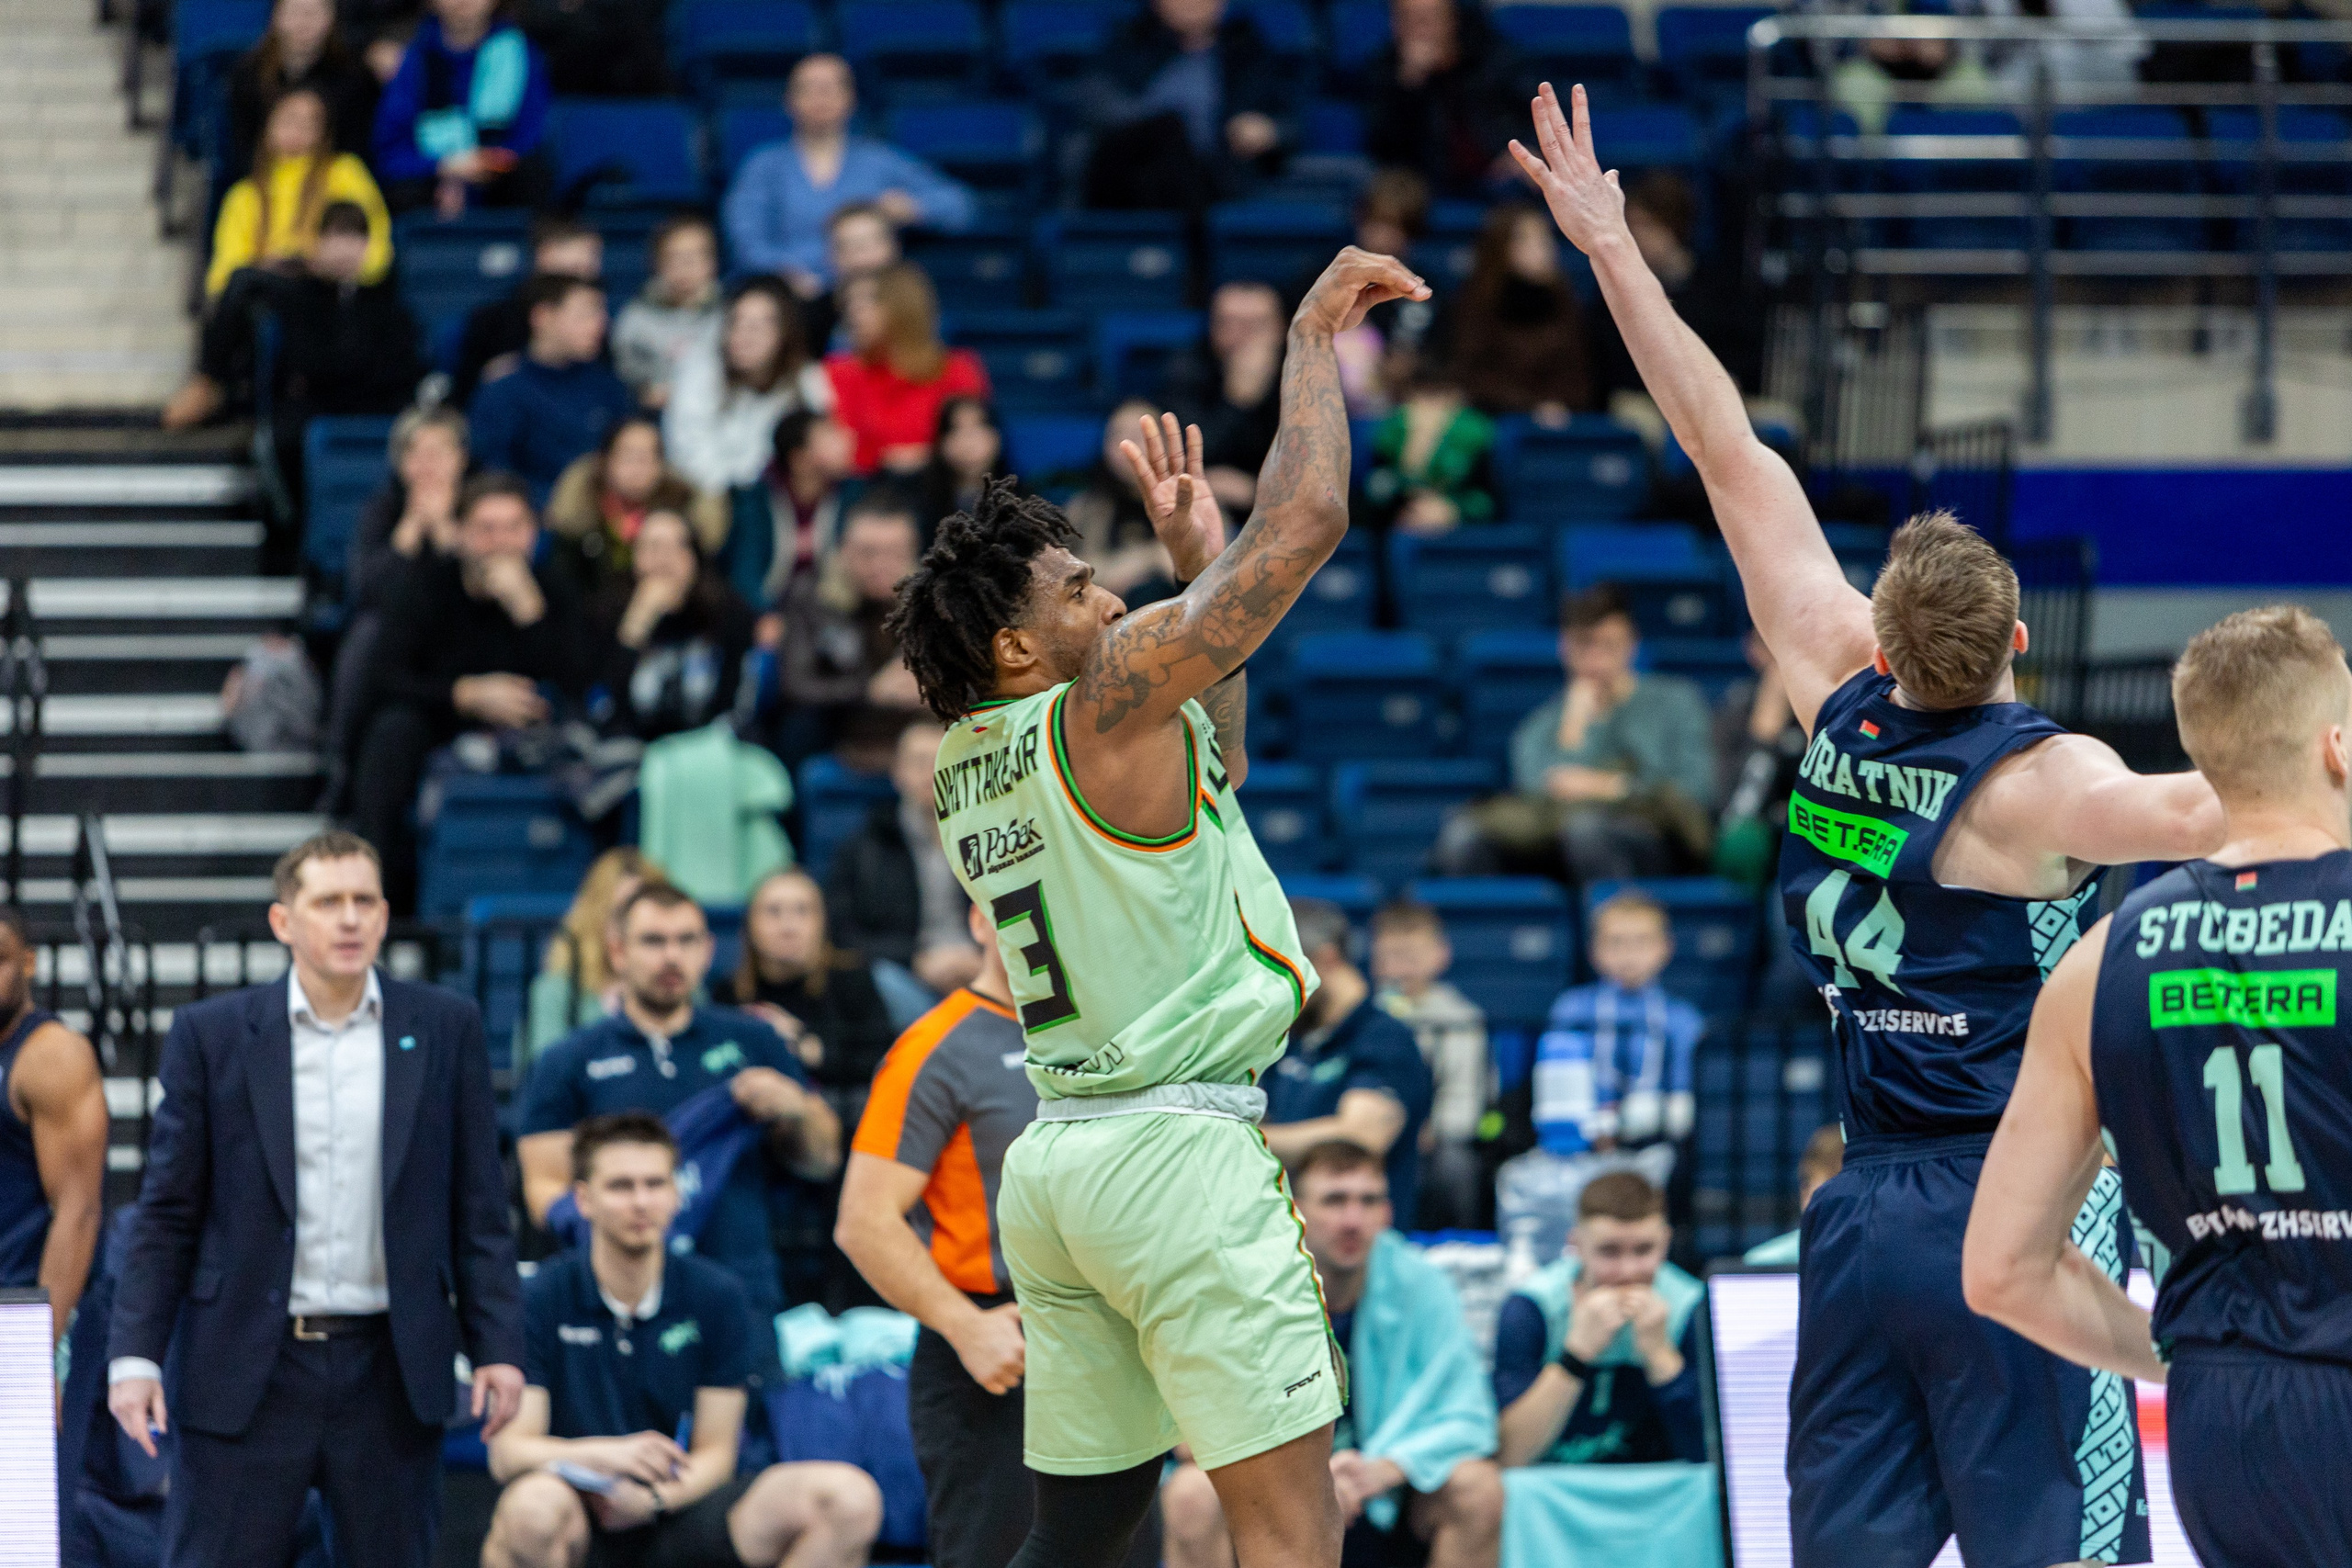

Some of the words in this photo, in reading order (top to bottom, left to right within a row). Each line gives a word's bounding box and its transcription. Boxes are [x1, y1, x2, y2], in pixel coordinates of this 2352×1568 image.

[989, 879, 1081, 1035] 3
[1804, 868, 1906, 998] 44
[2202, 1043, 2306, 1195] 11
